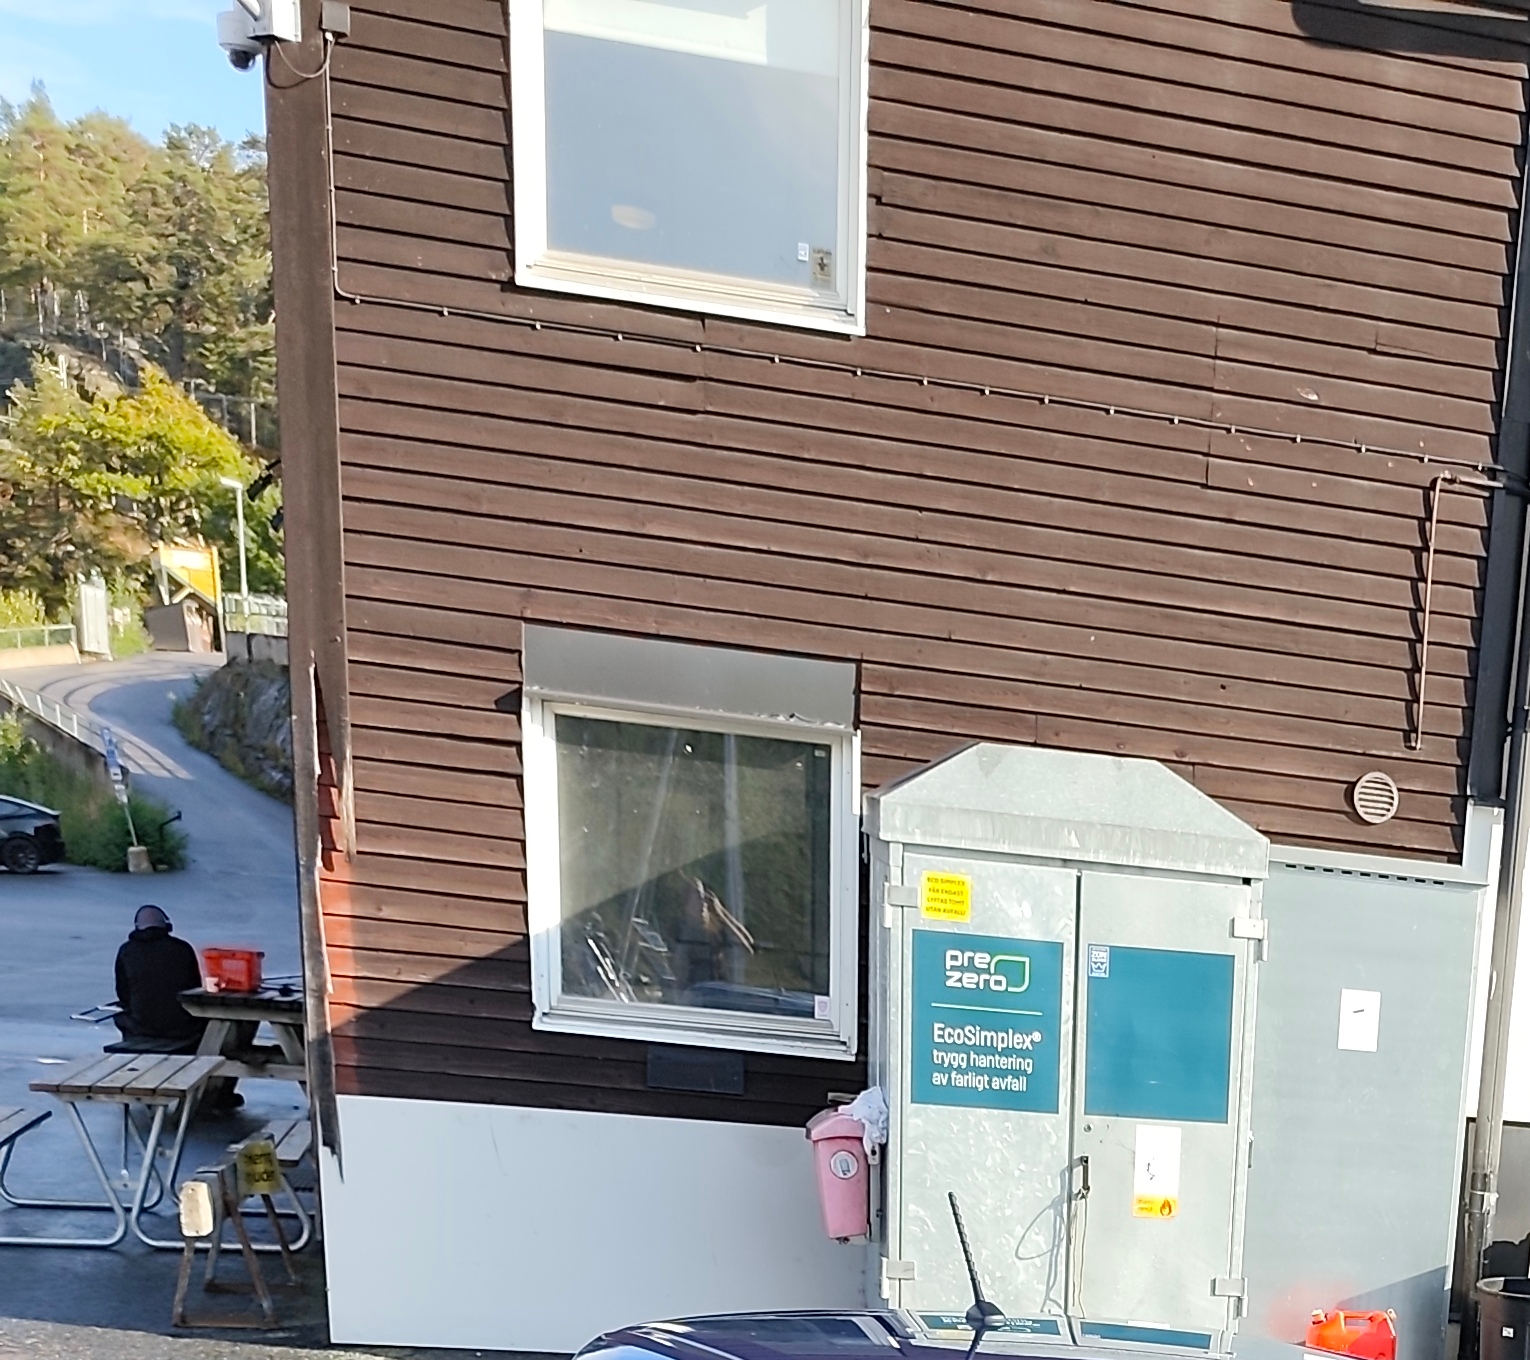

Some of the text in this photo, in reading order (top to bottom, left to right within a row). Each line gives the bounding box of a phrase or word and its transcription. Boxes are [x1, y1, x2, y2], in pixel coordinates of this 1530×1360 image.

[945, 949, 991, 970] pre
[945, 970, 1007, 992] zero
[932, 1049, 1033, 1074] trygg hantering
[931, 1070, 1027, 1092] av farligt avfall
